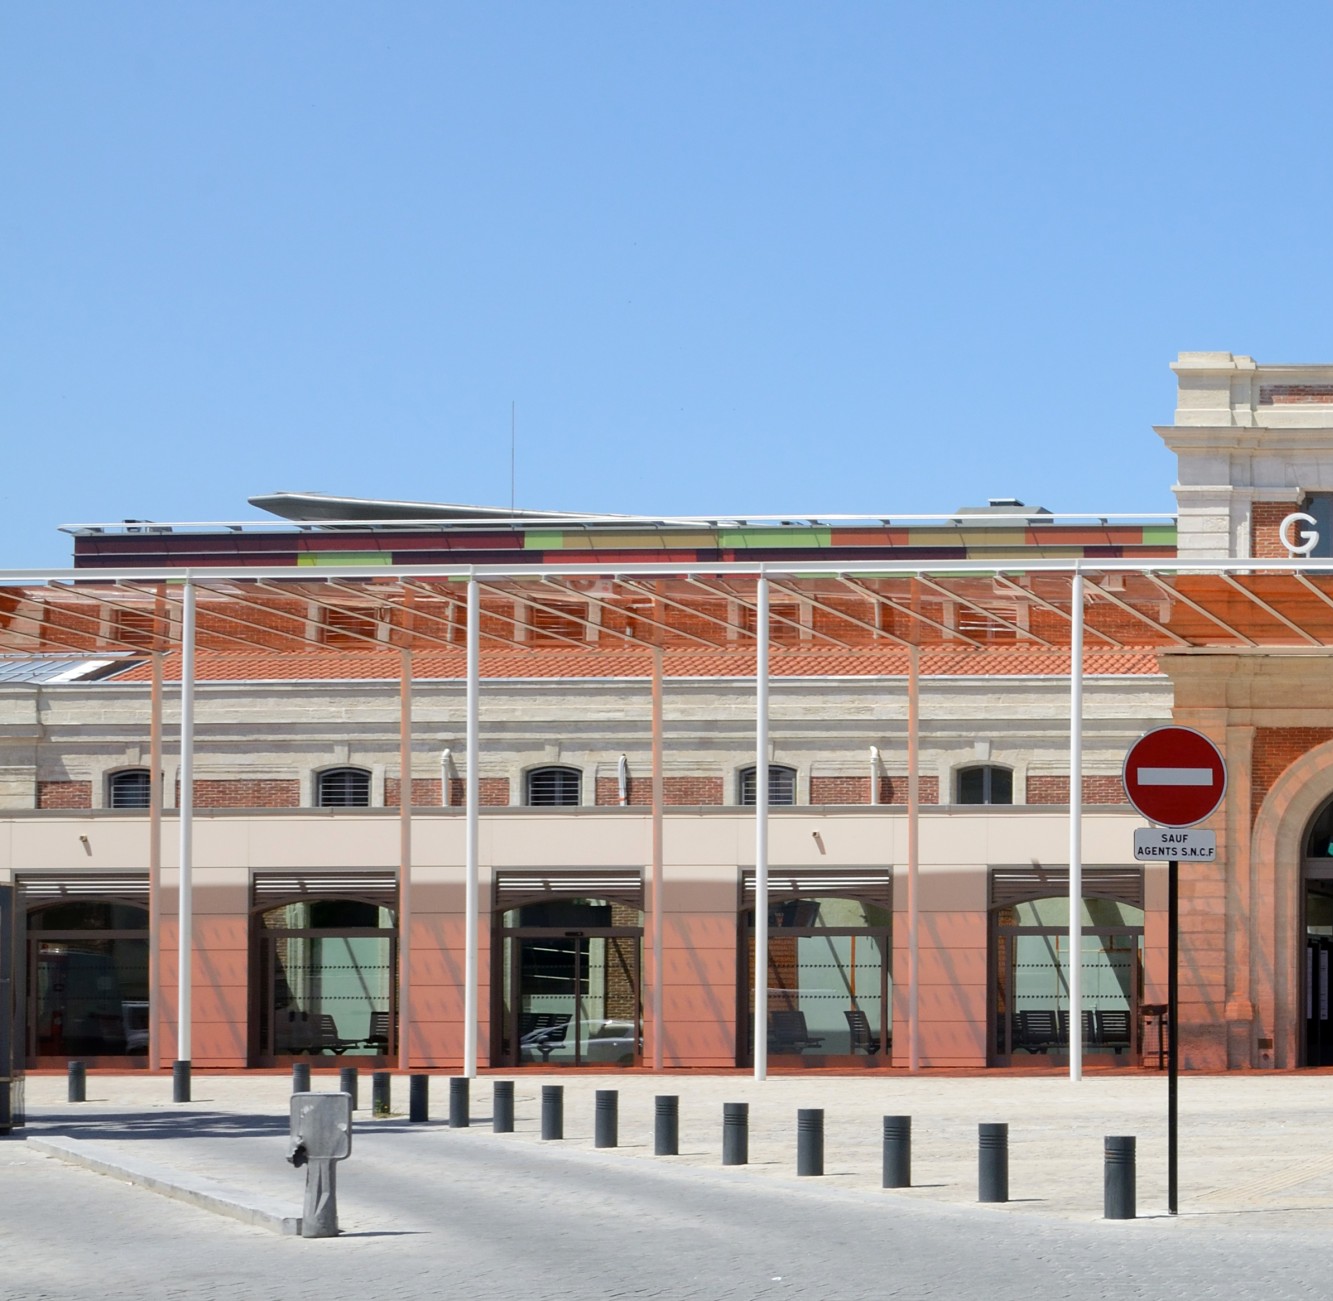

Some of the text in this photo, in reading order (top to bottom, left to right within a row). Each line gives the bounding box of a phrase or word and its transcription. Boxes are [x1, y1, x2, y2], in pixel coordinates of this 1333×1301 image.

[1161, 833, 1189, 843] SAUF
[1137, 846, 1214, 857] AGENTS S.N.C.F
